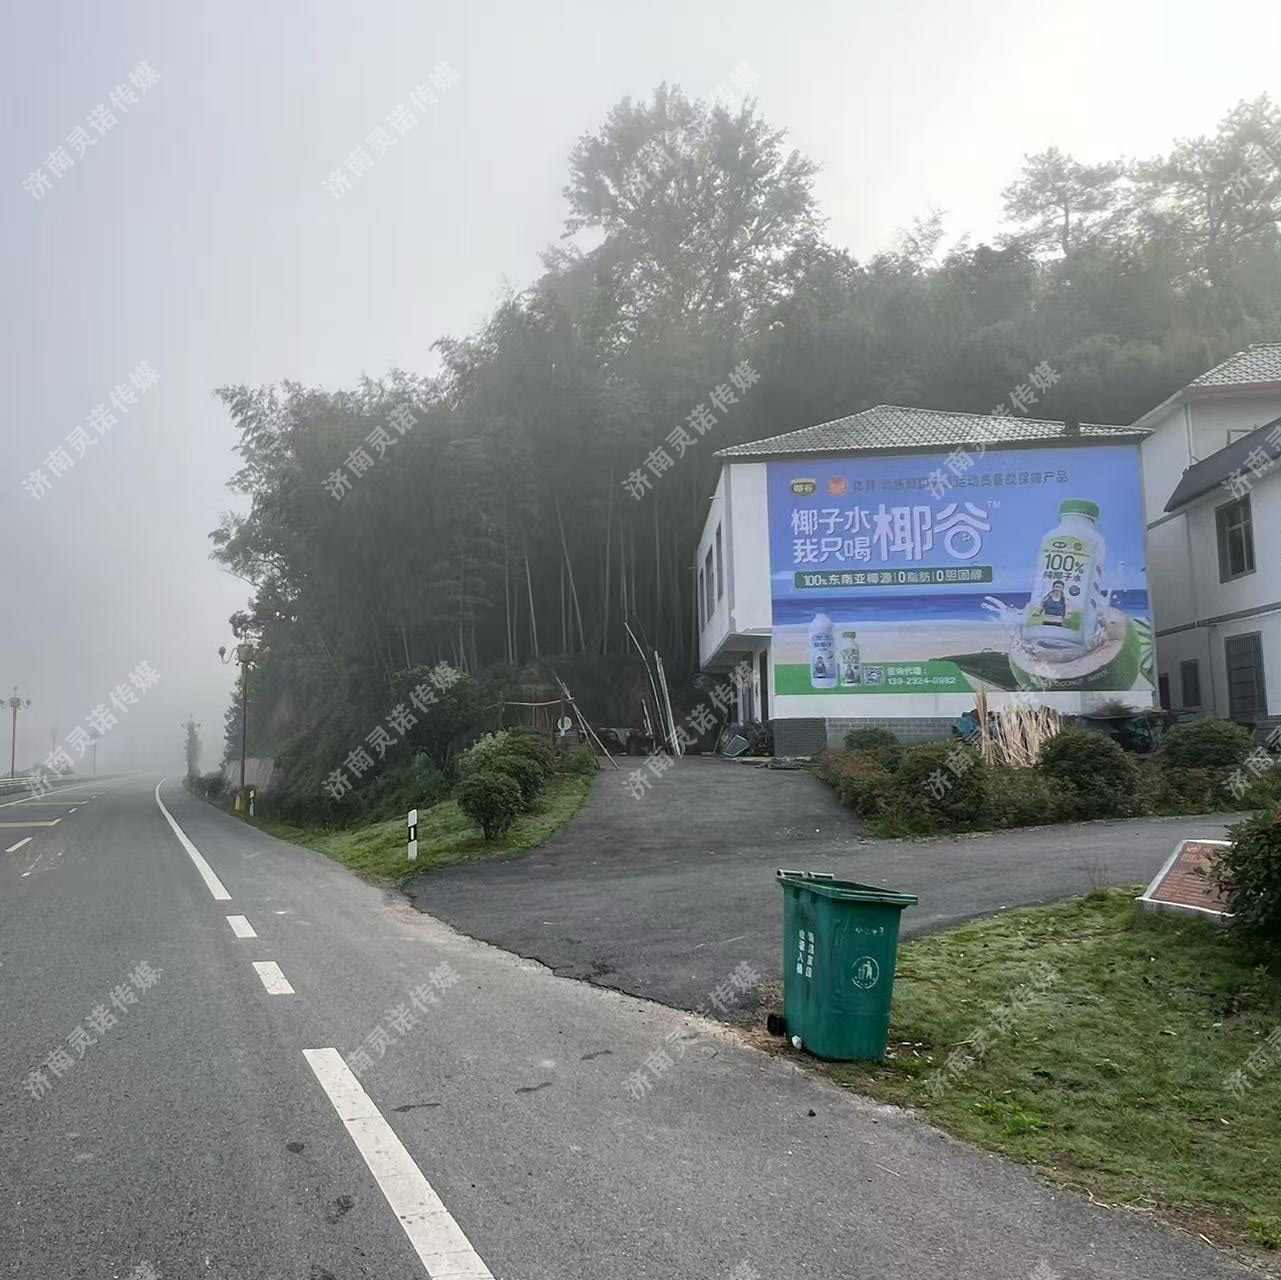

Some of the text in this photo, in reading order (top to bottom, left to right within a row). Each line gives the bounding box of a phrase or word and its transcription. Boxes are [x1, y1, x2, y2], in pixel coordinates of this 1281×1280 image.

[790, 506, 871, 535] 椰子水
[873, 502, 991, 561] 椰谷
[792, 537, 871, 564] 我只喝
[1044, 554, 1085, 574] 100%
